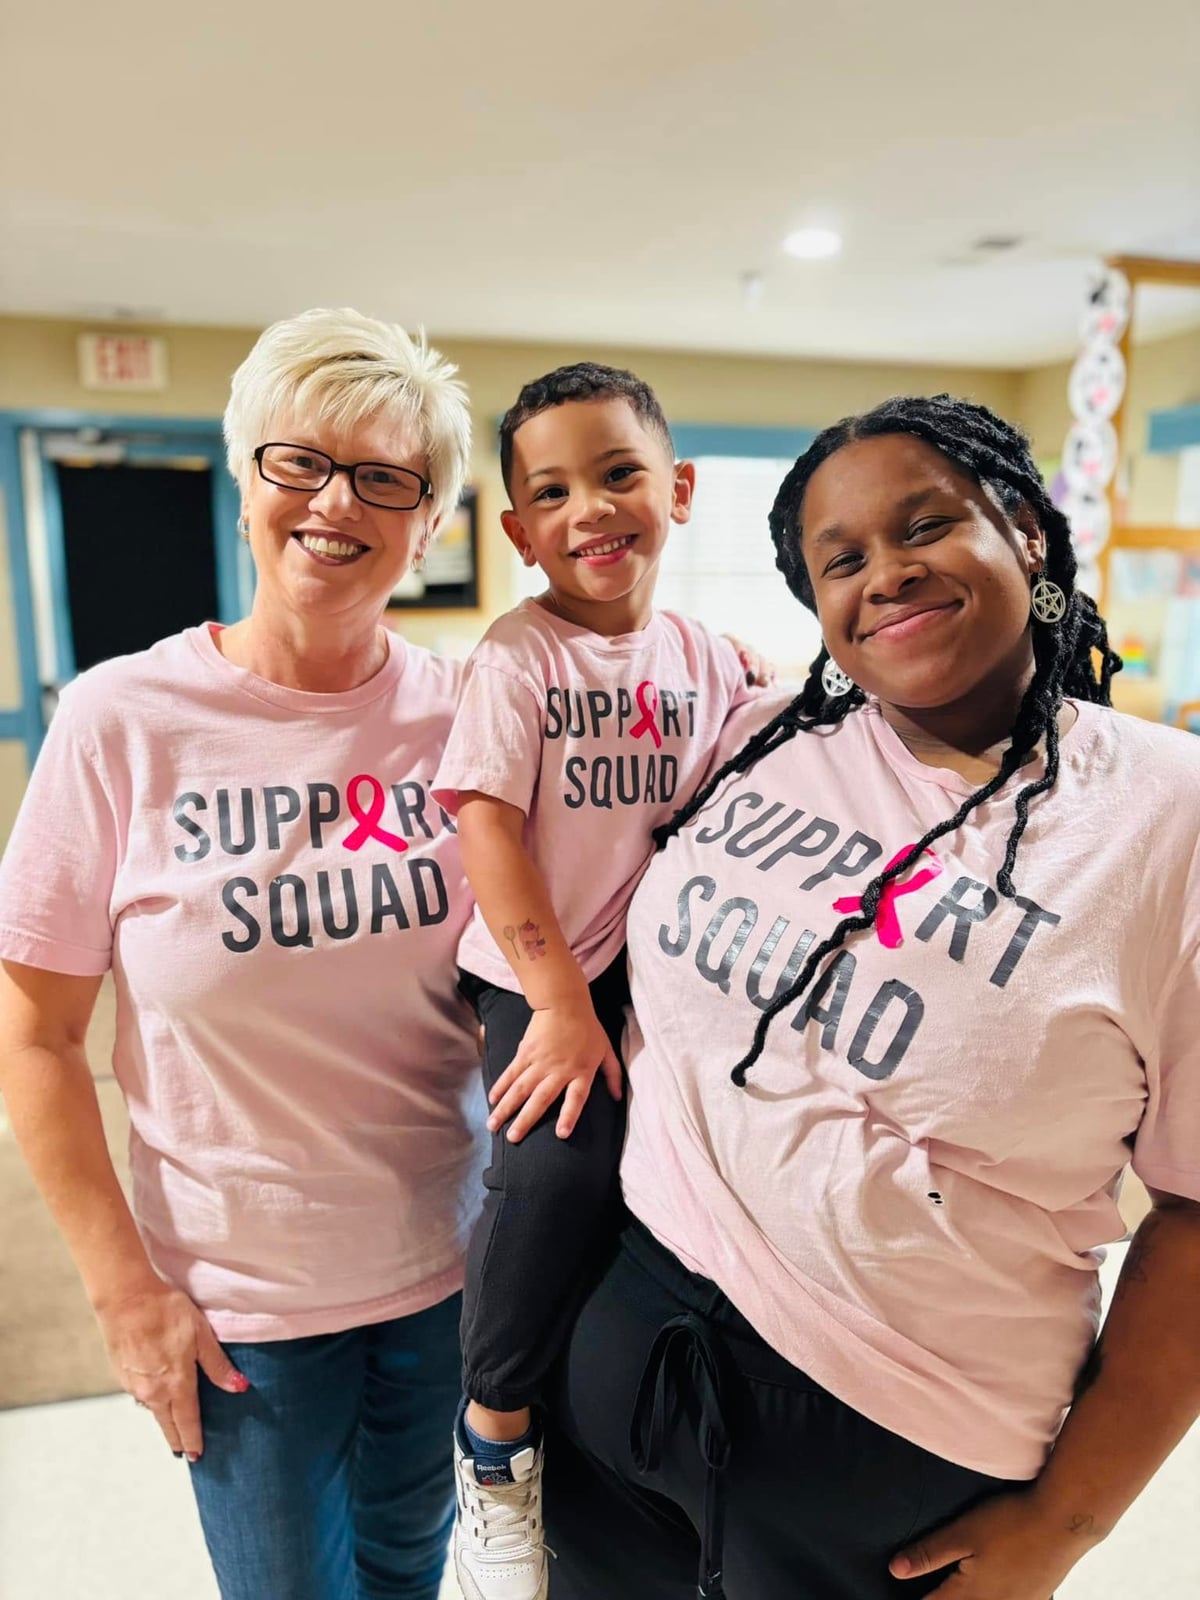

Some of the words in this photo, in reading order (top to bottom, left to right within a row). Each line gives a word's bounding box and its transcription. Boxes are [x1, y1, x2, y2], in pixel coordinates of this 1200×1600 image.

[564, 754, 678, 810] SQUAD
[221, 857, 450, 953] SQUAD
[658, 875, 925, 1081] SQUAD
[476, 1464, 507, 1472] Reebok
